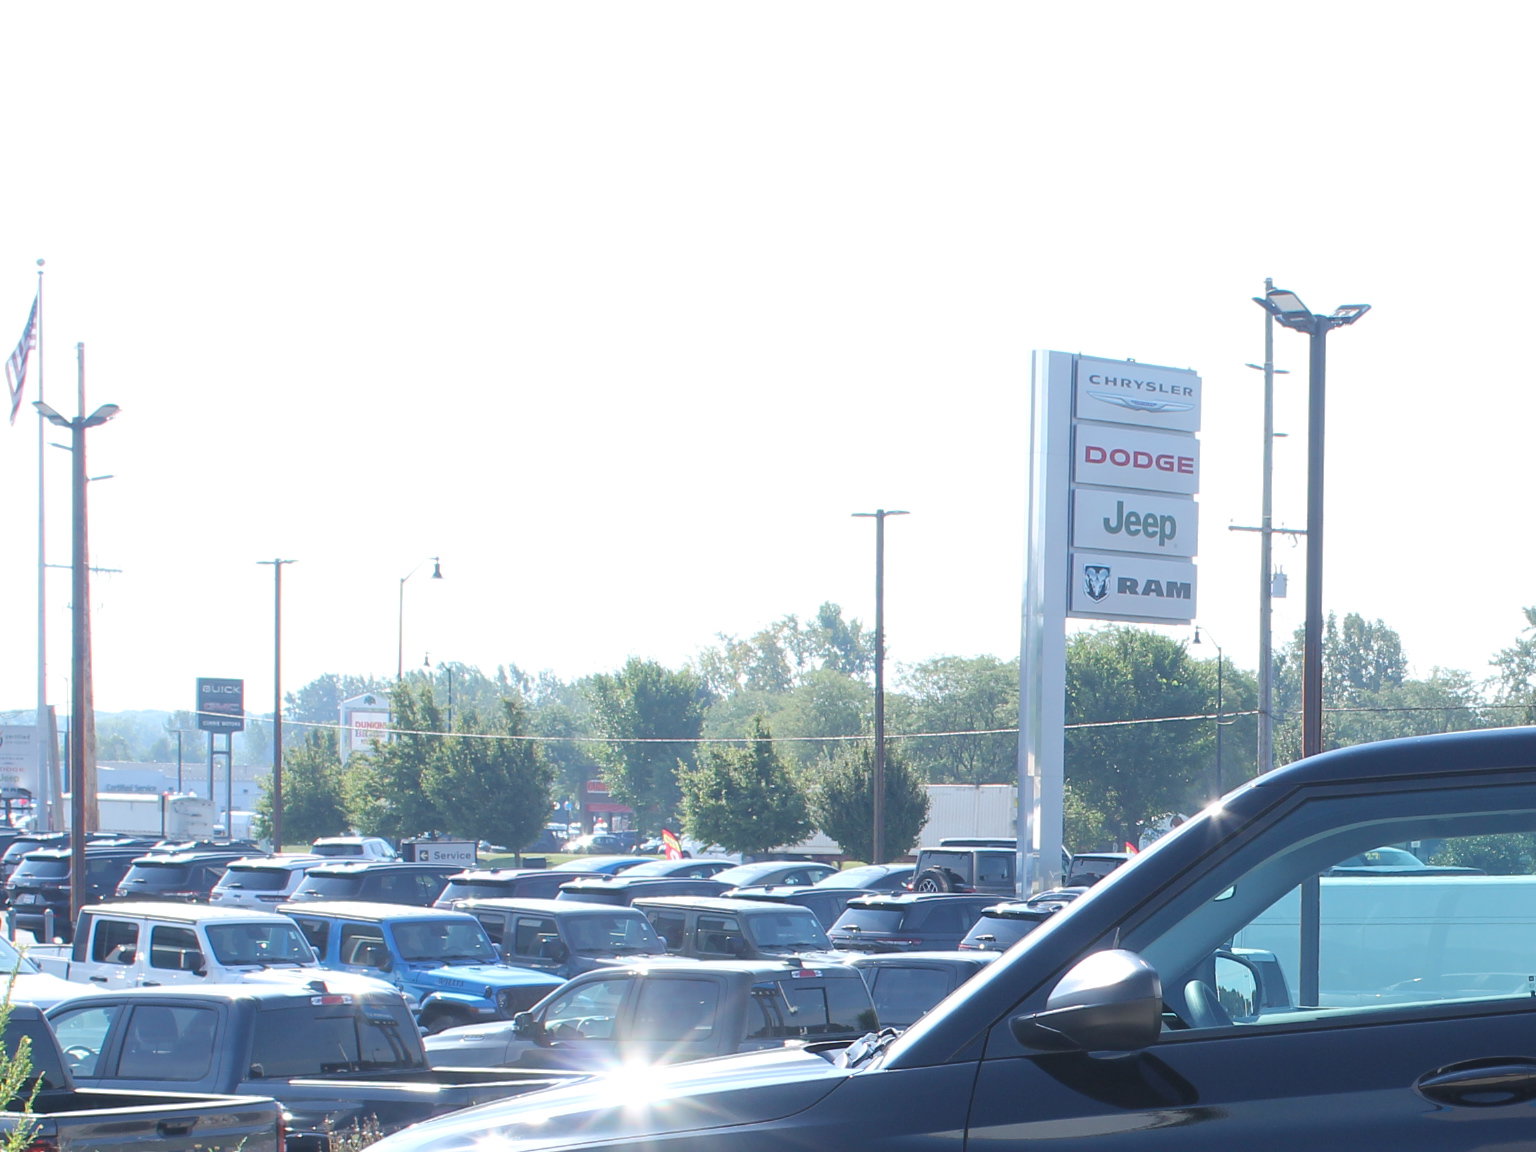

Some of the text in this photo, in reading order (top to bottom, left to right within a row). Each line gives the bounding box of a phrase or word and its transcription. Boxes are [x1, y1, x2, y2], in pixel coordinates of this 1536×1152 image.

[1088, 374, 1194, 397] CHRYSLER
[1085, 445, 1194, 474] DODGE
[1103, 500, 1177, 546] Jeep
[1117, 576, 1192, 600] RAM
[202, 685, 241, 694] BUICK
[203, 702, 240, 711] GMC
[434, 851, 472, 860] Service
